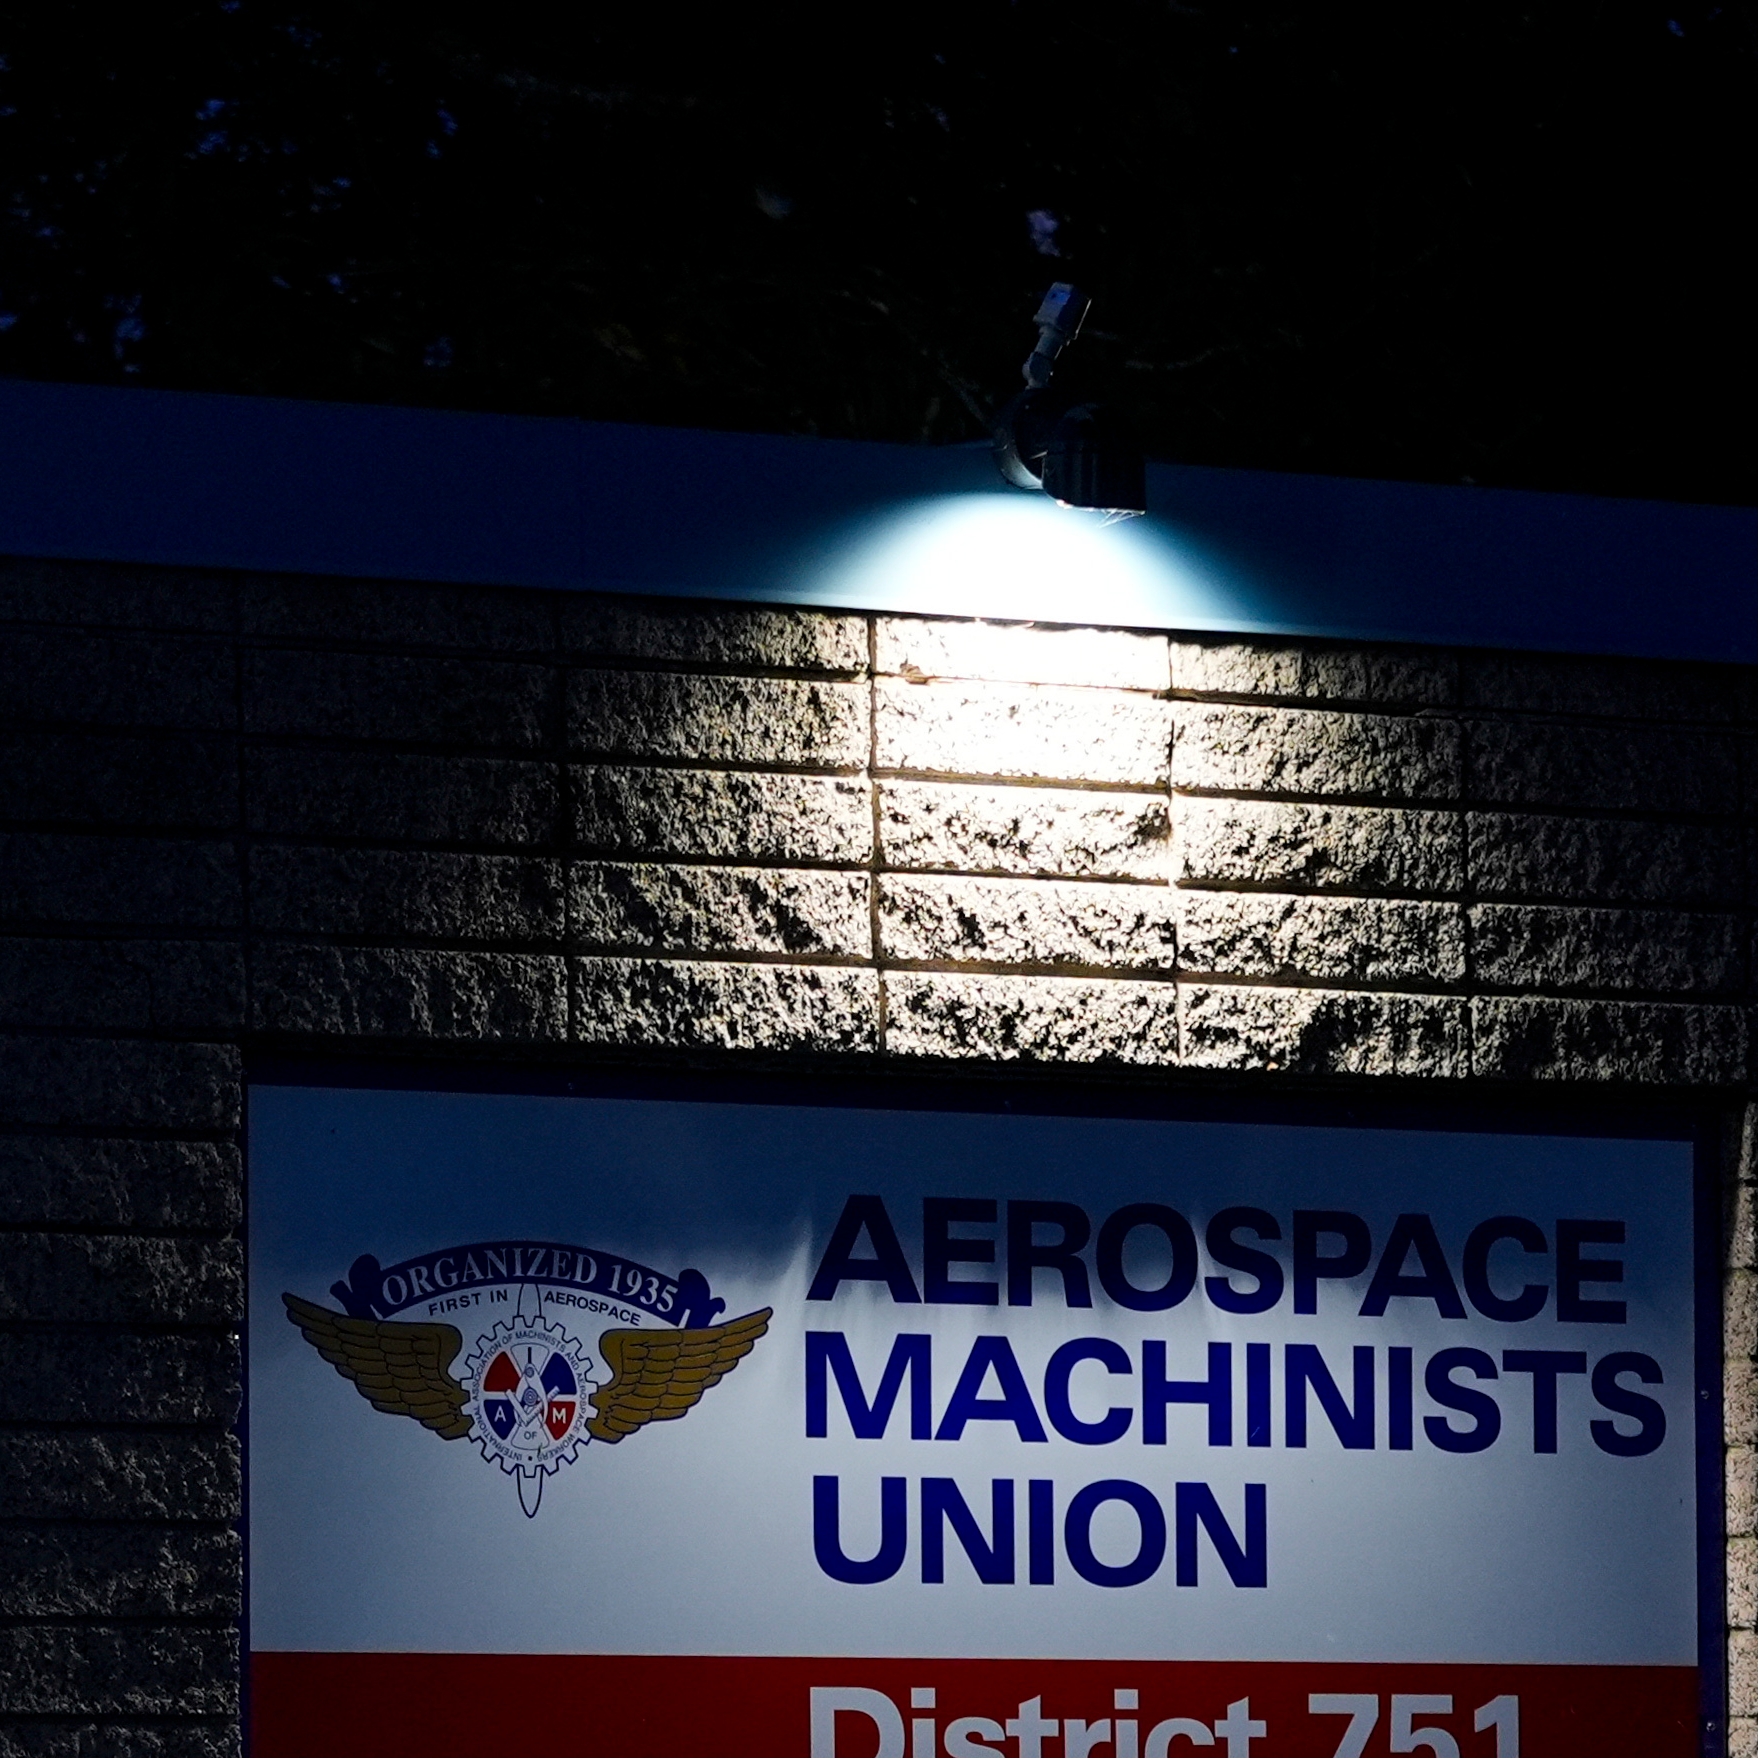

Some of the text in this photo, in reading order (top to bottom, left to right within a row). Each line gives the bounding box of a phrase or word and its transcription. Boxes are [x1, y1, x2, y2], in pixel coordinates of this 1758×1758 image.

[382, 1248, 679, 1313] ORGANIZED 1935
[805, 1194, 1627, 1325] AEROSPACE
[428, 1289, 641, 1326] FIRST IN AEROSPACE
[472, 1341, 502, 1402] ASSOCIATION
[502, 1333, 513, 1345] OF
[805, 1330, 1667, 1458] MACHINISTS
[493, 1404, 567, 1425] A M
[523, 1430, 538, 1441] OF
[812, 1475, 1268, 1589] UNION
